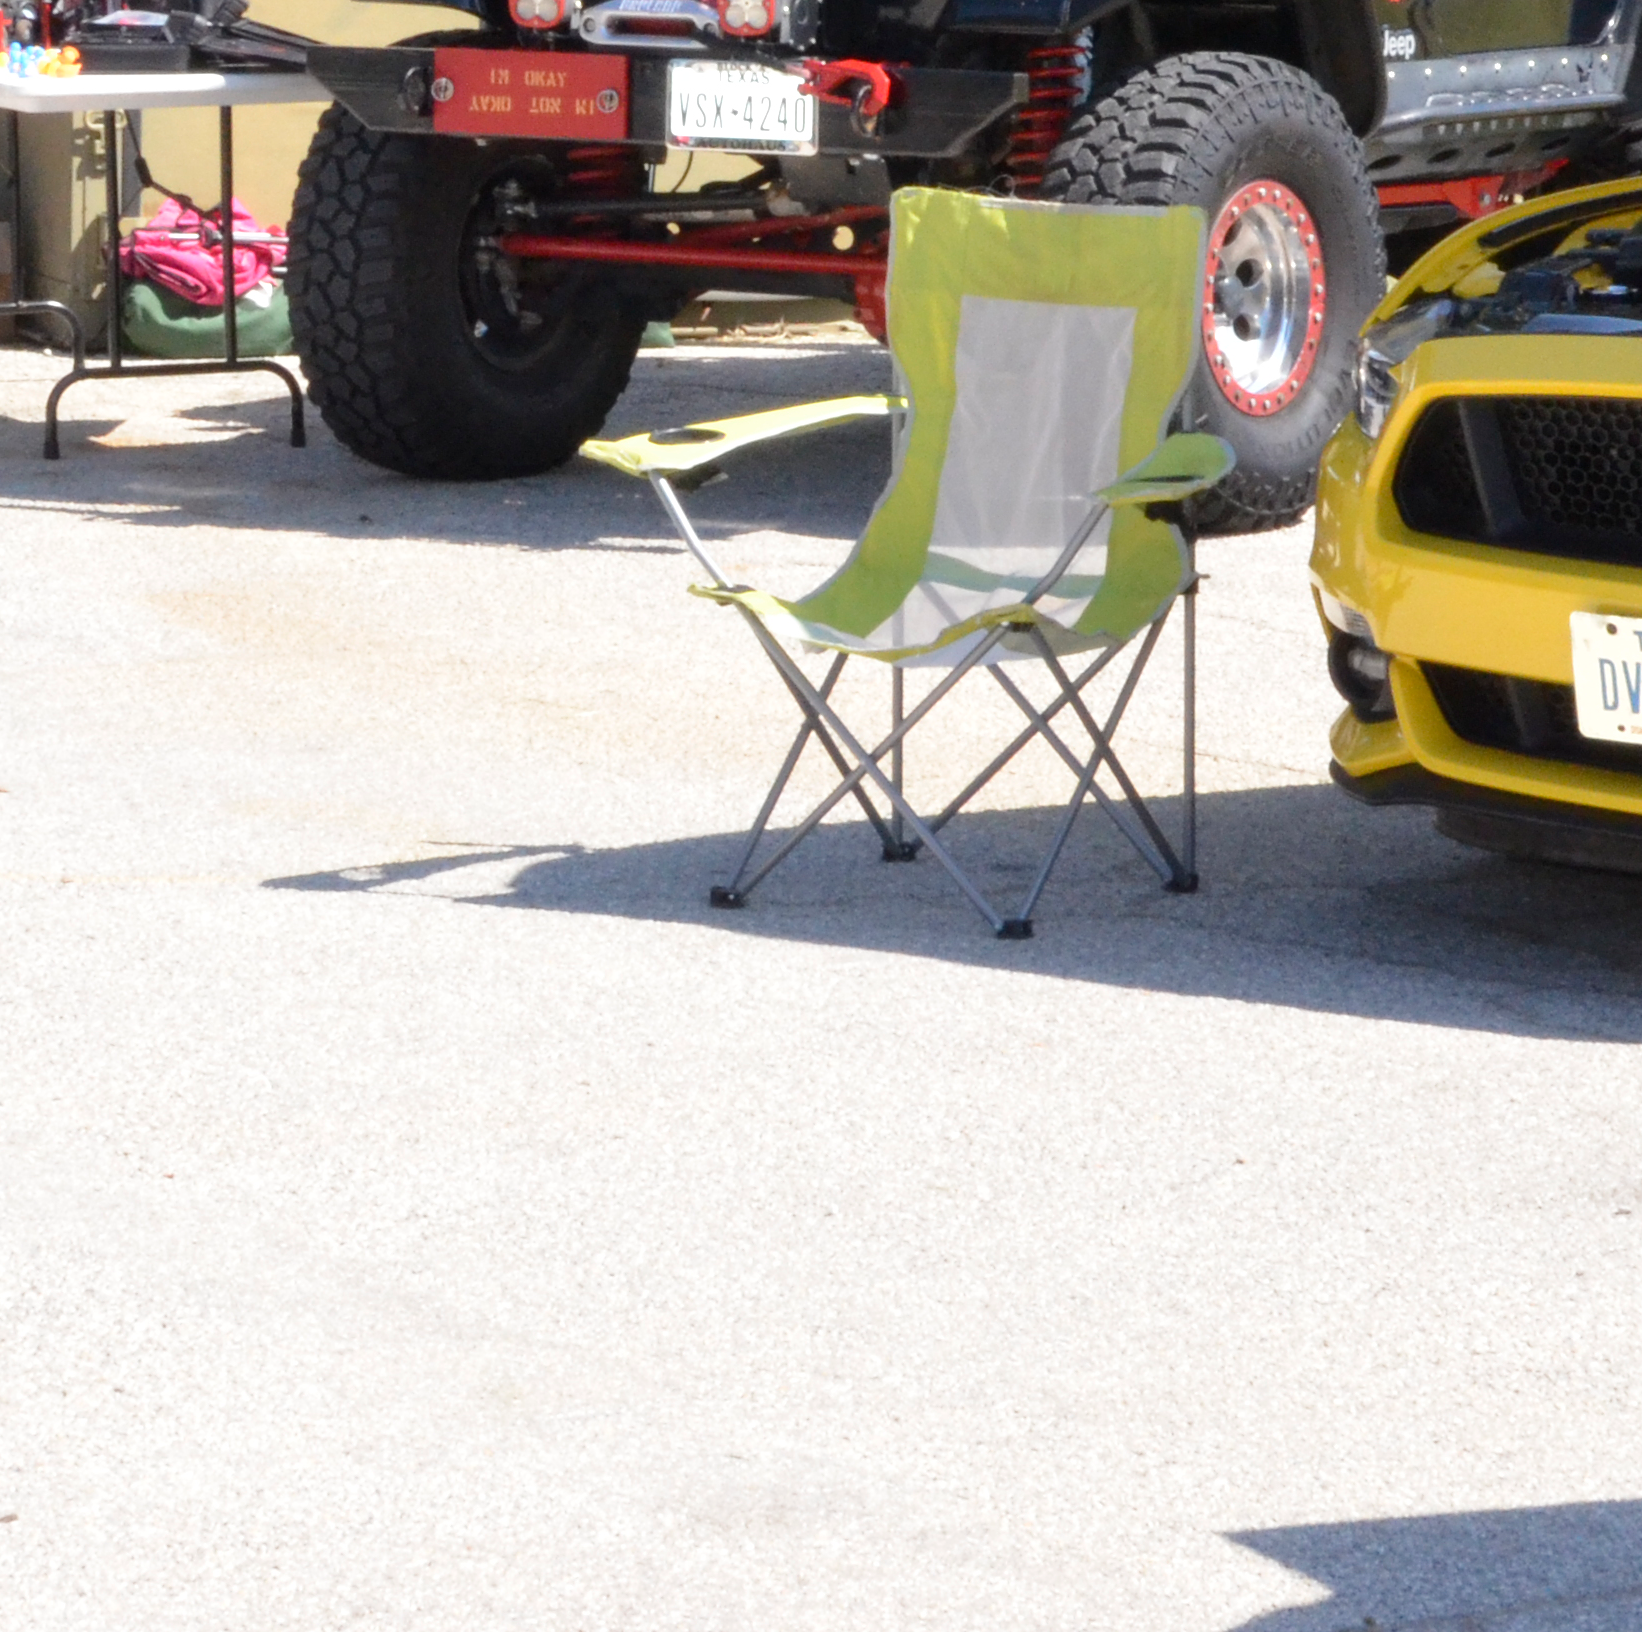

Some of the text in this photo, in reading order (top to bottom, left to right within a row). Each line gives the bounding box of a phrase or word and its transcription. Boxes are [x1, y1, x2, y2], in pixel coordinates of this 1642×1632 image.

[1383, 28, 1416, 60] Jeep
[524, 70, 567, 88] OKAY
[719, 70, 770, 85] TEXAS
[469, 95, 512, 112] OKAY
[529, 97, 562, 114] NOT
